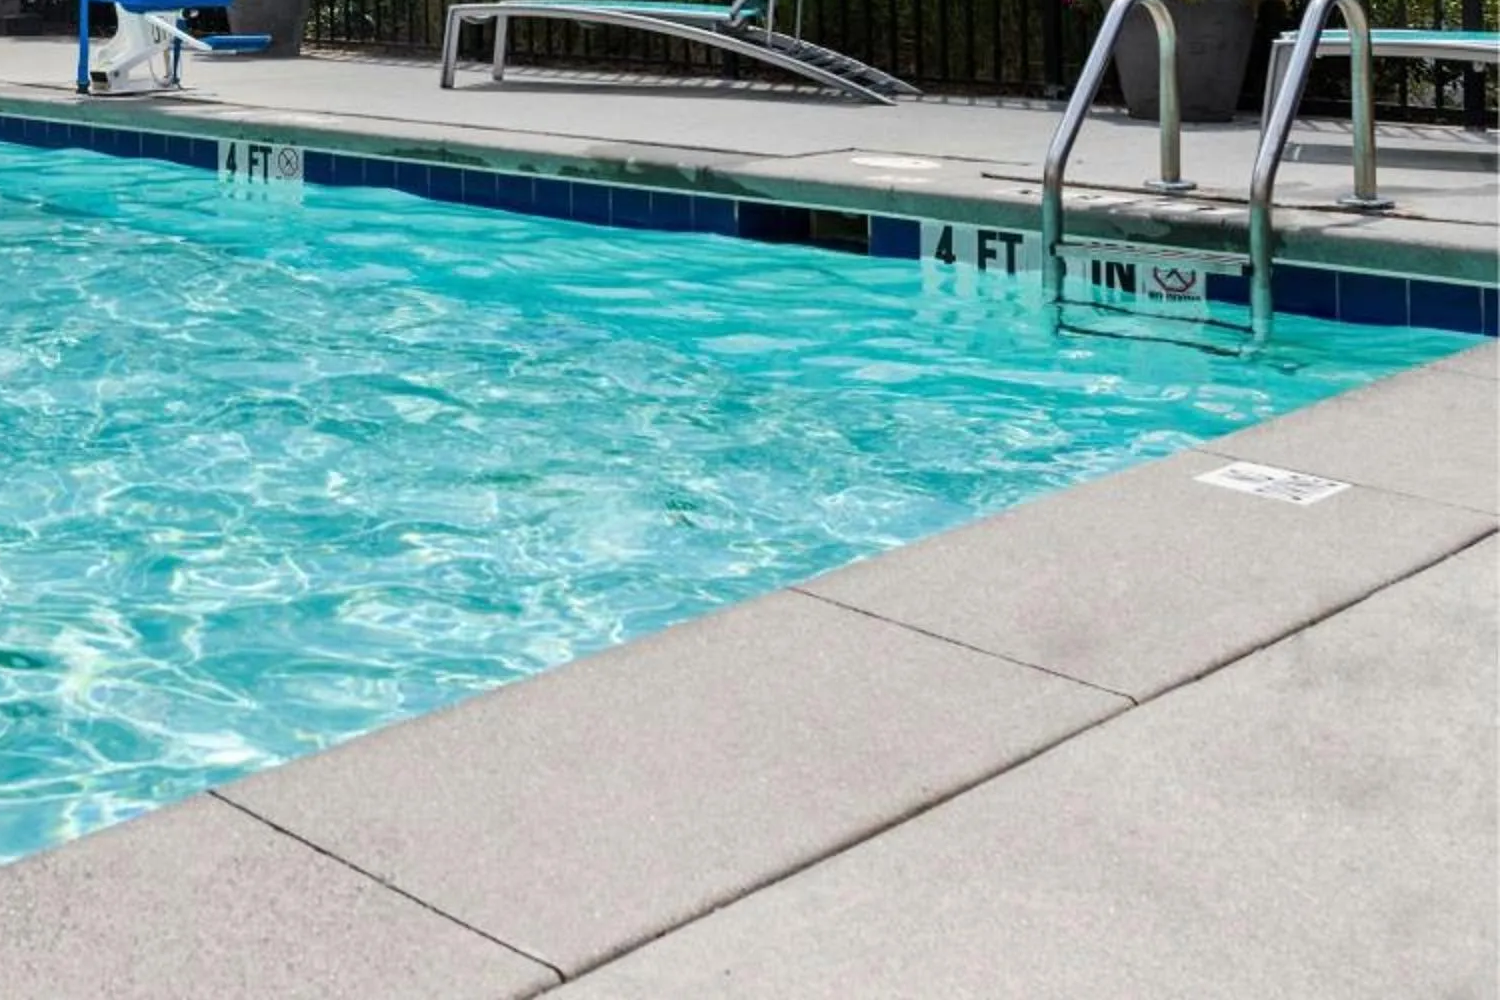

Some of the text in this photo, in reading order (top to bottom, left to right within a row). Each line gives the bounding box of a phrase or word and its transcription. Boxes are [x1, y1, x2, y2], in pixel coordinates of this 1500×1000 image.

[226, 142, 273, 184] 4 FT
[935, 224, 956, 265] 4
[977, 229, 1024, 276] FT
[1091, 259, 1137, 294] IN
